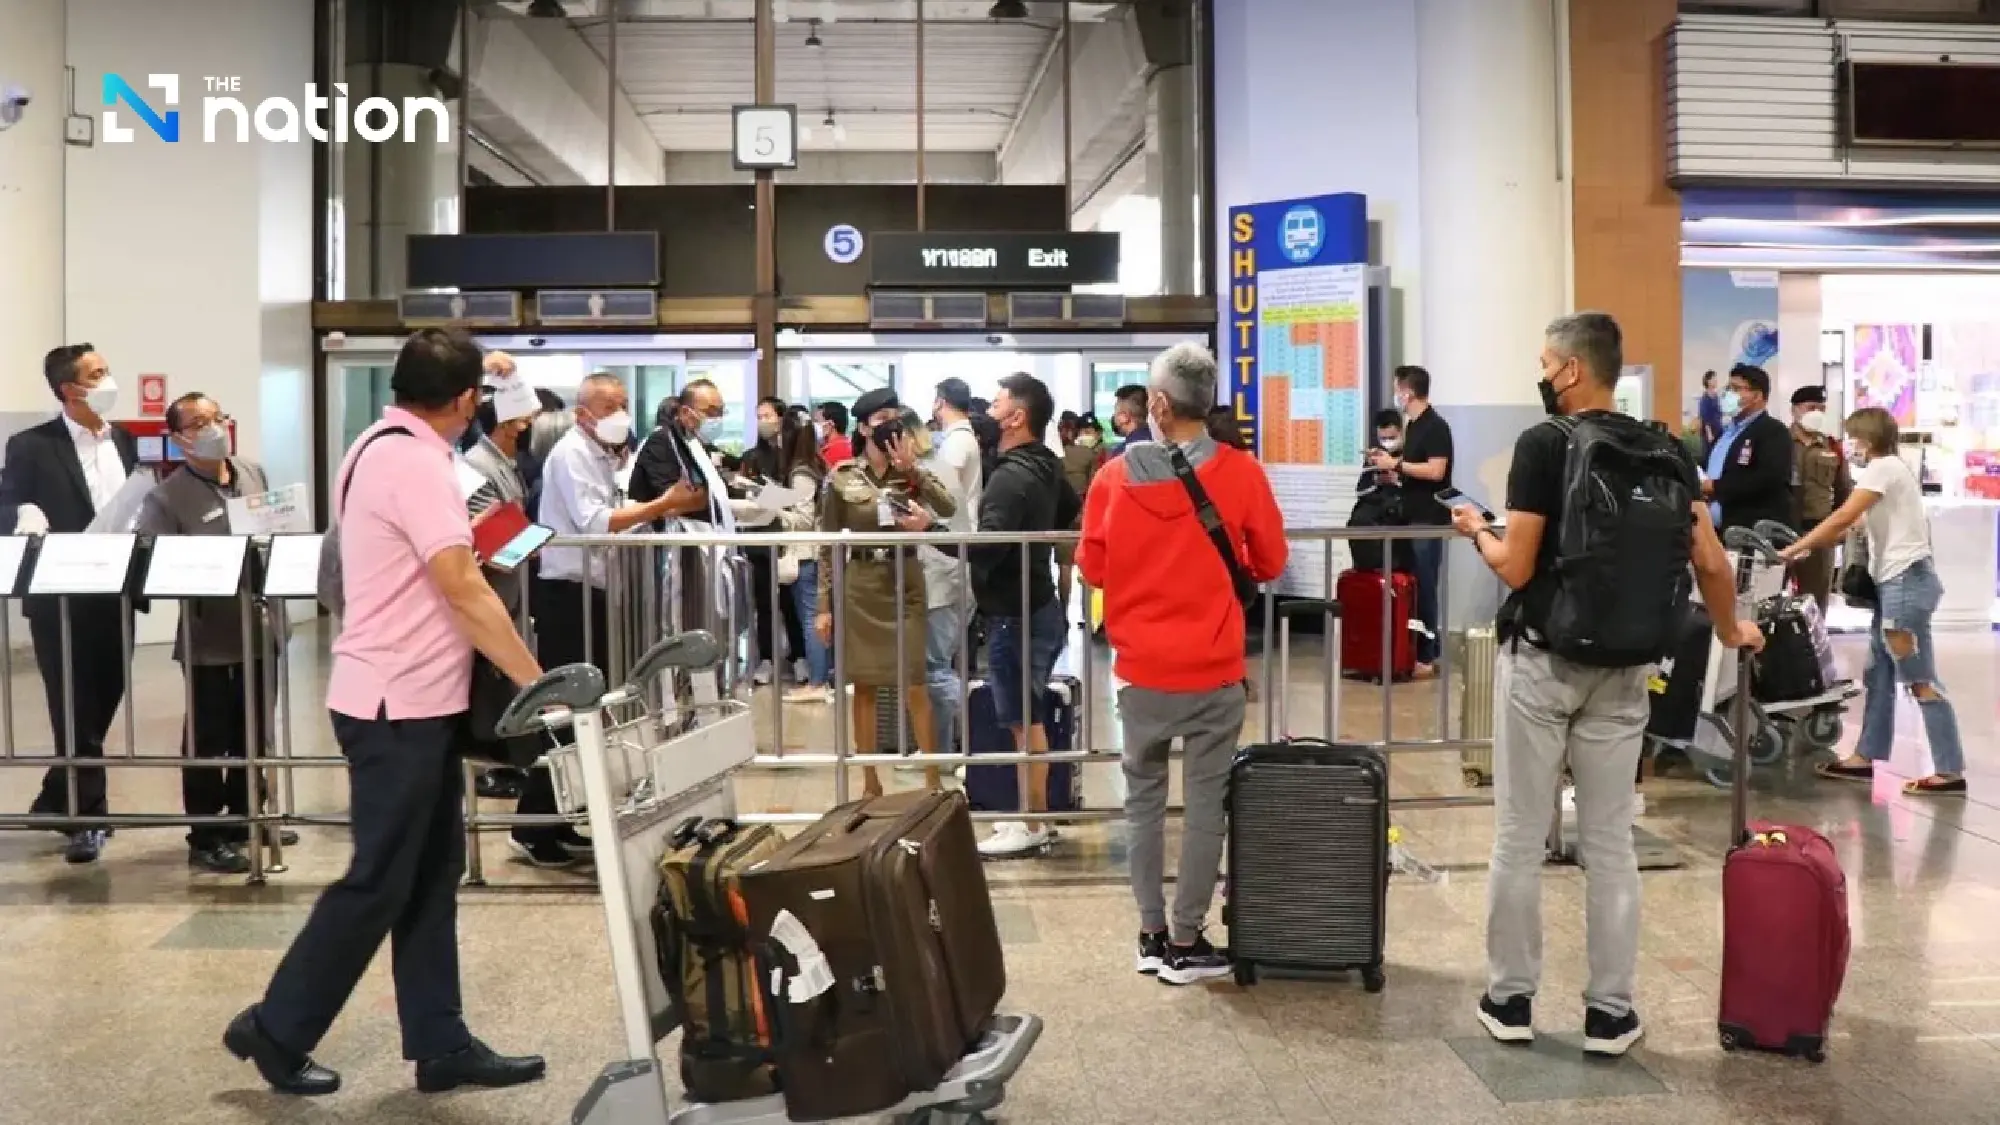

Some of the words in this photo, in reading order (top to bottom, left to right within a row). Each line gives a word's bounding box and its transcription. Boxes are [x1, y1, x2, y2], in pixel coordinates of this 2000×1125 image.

[754, 125, 775, 156] 5
[832, 230, 856, 256] 5
[921, 248, 998, 267] ทางออก
[1027, 248, 1069, 267] Exit
